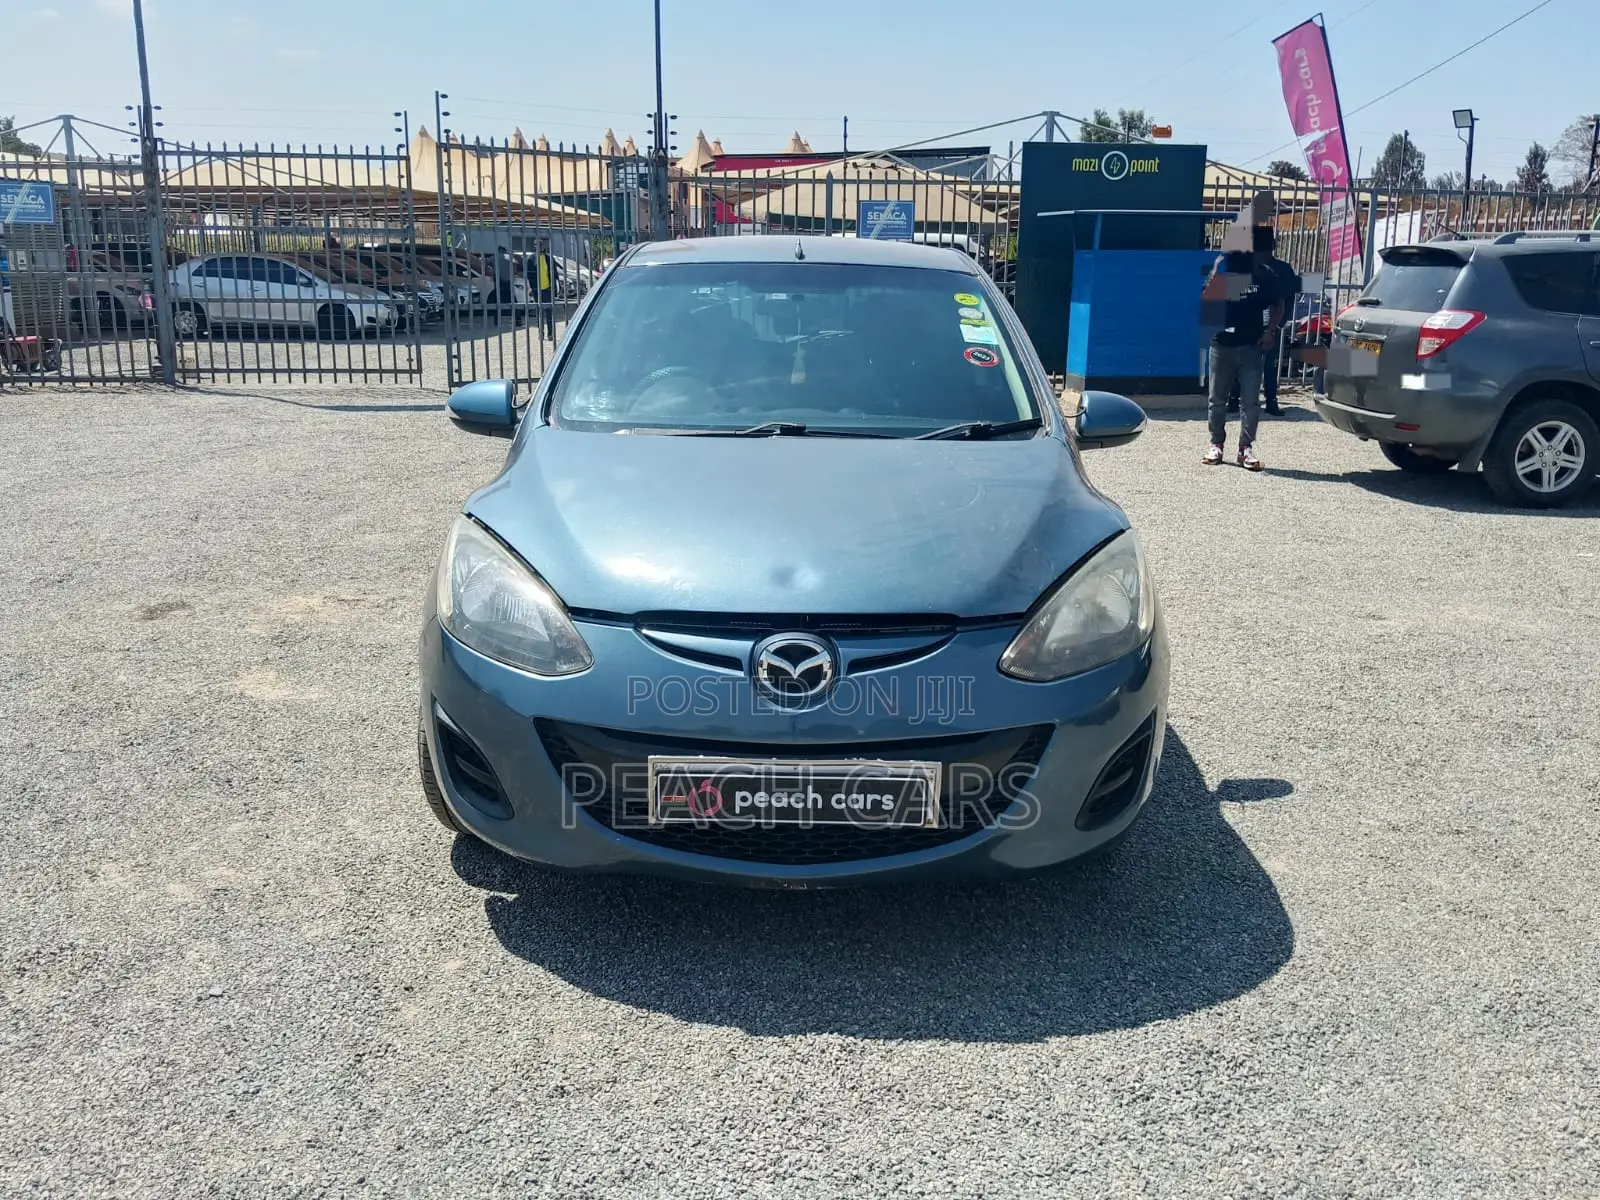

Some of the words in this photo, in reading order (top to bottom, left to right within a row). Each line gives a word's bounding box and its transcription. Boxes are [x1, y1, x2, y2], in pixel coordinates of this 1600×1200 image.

[1072, 158, 1098, 171] mozi
[1130, 157, 1159, 176] point
[735, 785, 822, 814] peach
[830, 790, 895, 811] cars
